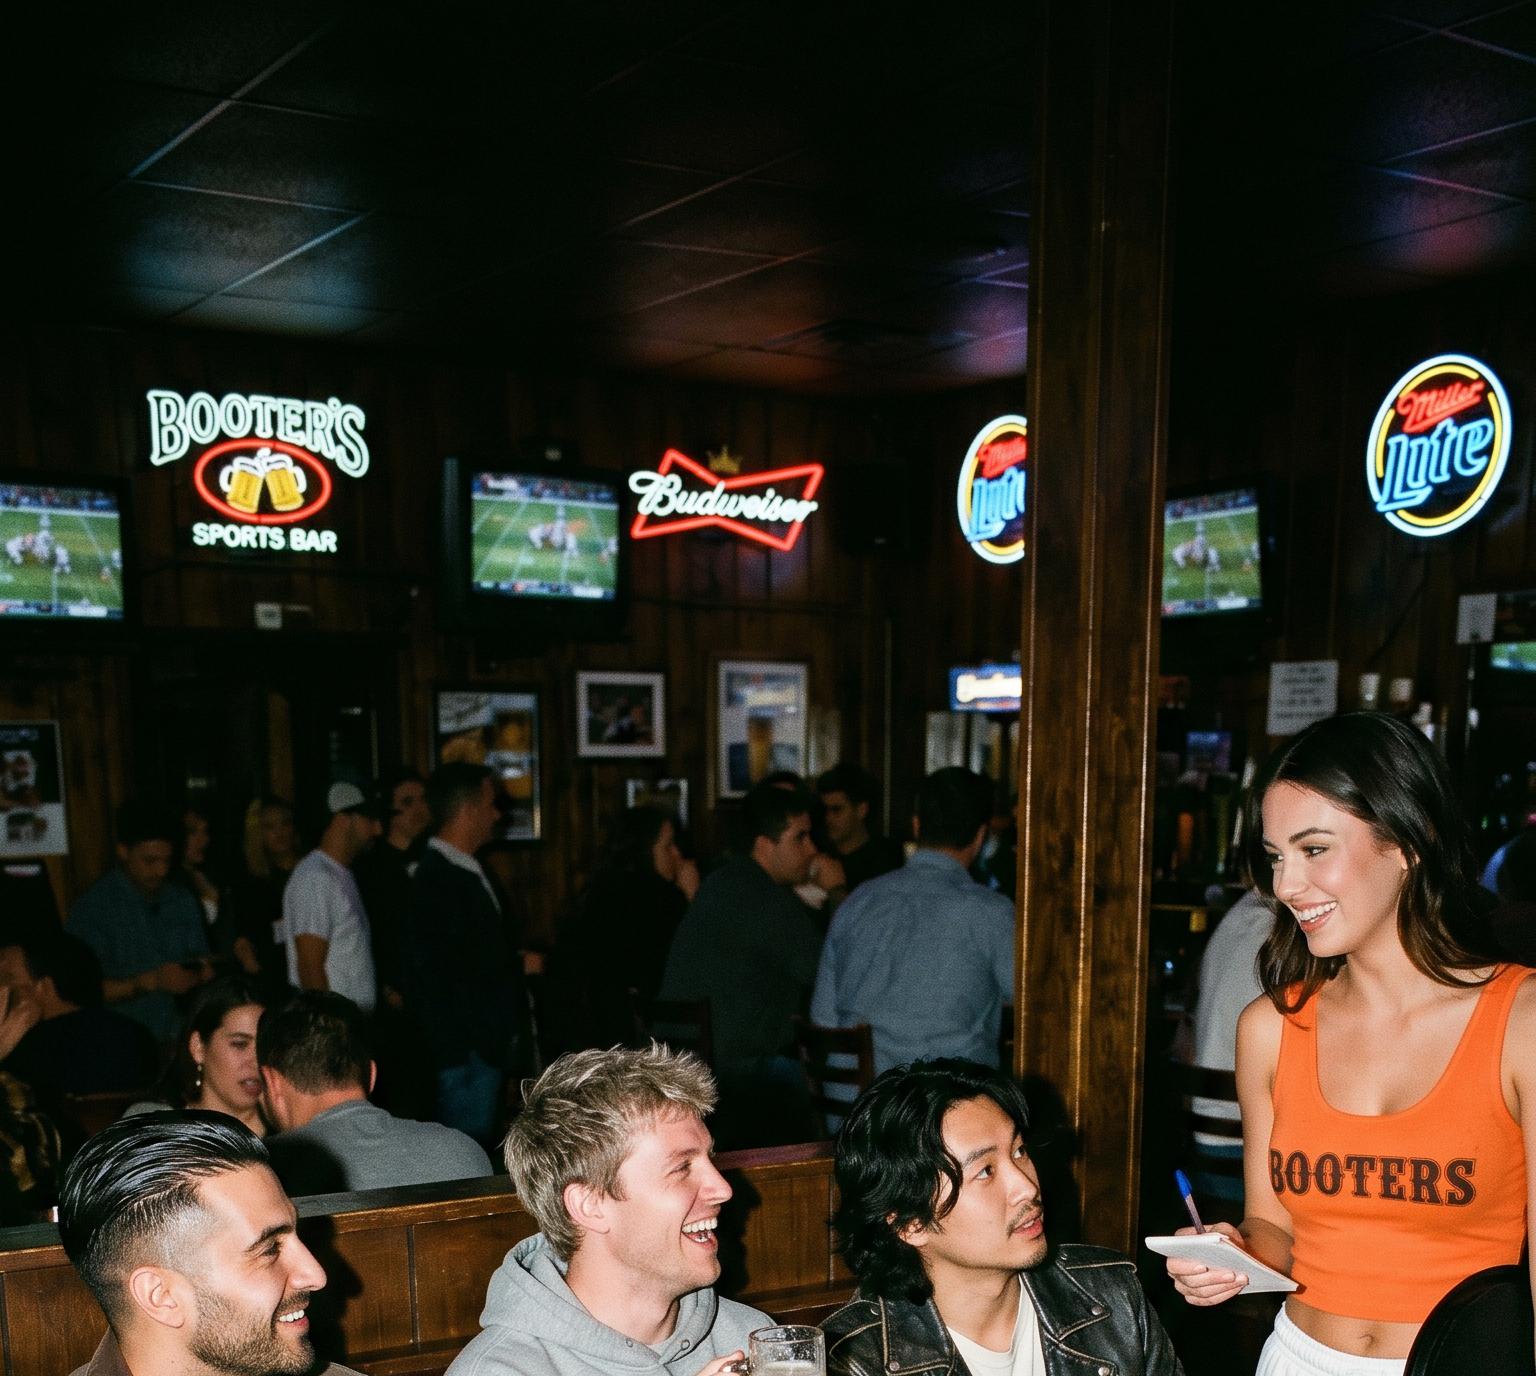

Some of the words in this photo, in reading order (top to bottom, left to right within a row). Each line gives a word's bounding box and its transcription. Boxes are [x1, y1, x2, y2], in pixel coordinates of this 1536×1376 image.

[147, 390, 370, 478] BOOTER'S
[1396, 380, 1486, 434] Miller
[1376, 417, 1494, 512] Lite
[628, 470, 819, 523] Budweiser
[967, 466, 1026, 542] Lit
[192, 522, 286, 550] SPORTS
[289, 528, 338, 553] BAR
[1268, 1149, 1477, 1206] BOOTERS
